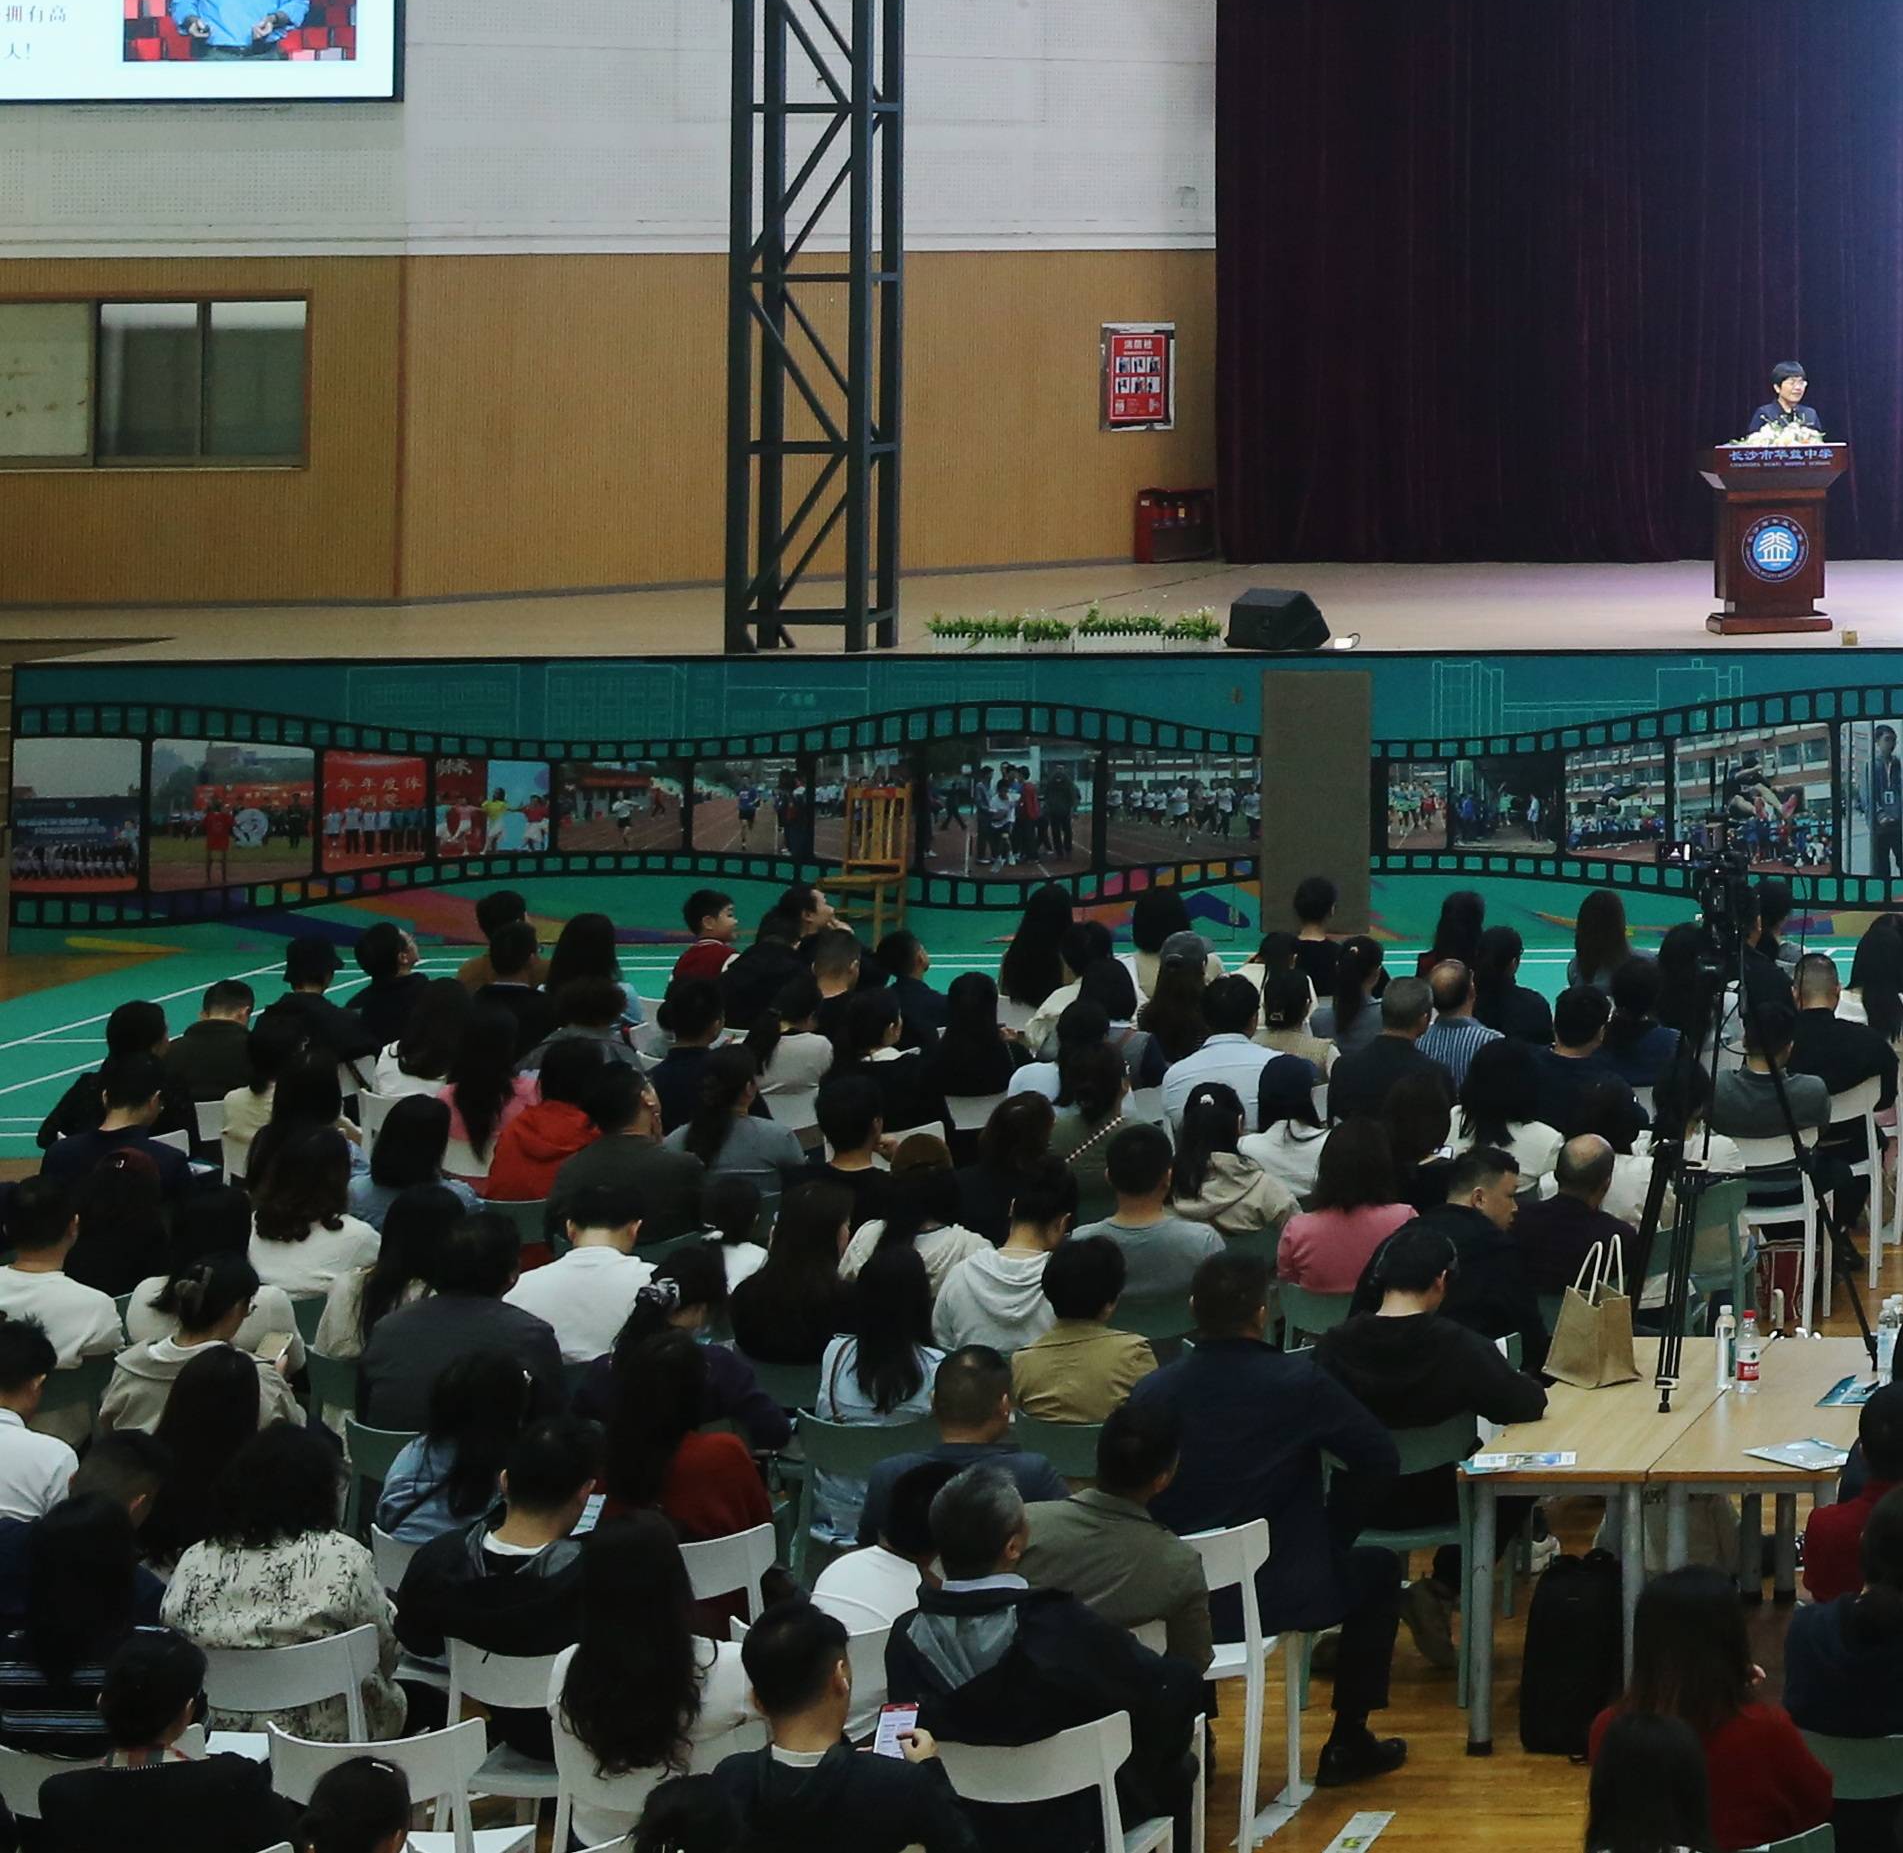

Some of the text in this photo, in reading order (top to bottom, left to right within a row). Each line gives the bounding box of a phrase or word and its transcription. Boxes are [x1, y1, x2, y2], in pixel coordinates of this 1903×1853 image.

[1729, 448, 1834, 461] 长沙市华益中学
